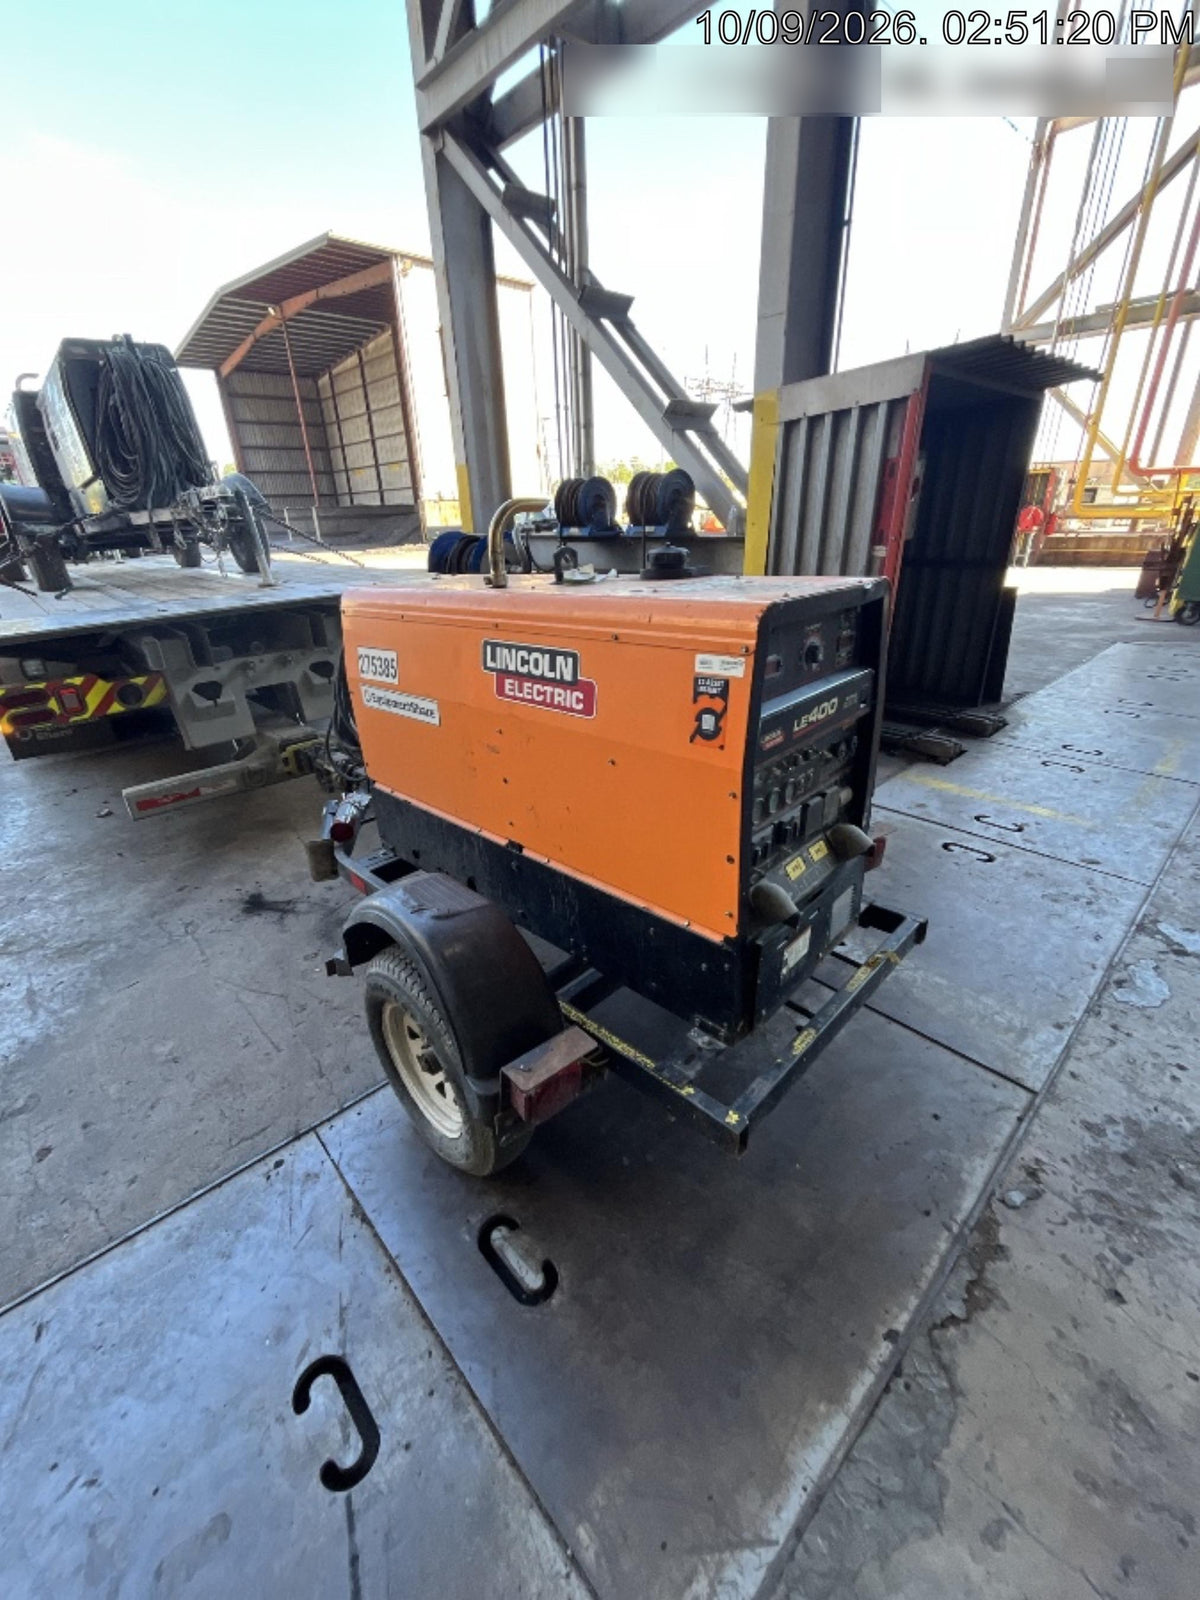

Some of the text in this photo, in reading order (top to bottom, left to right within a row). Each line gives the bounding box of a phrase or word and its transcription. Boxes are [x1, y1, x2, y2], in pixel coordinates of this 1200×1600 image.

[358, 653, 397, 679] 275385
[486, 645, 573, 681] LINCOLN
[504, 678, 584, 710] ELECTRIC
